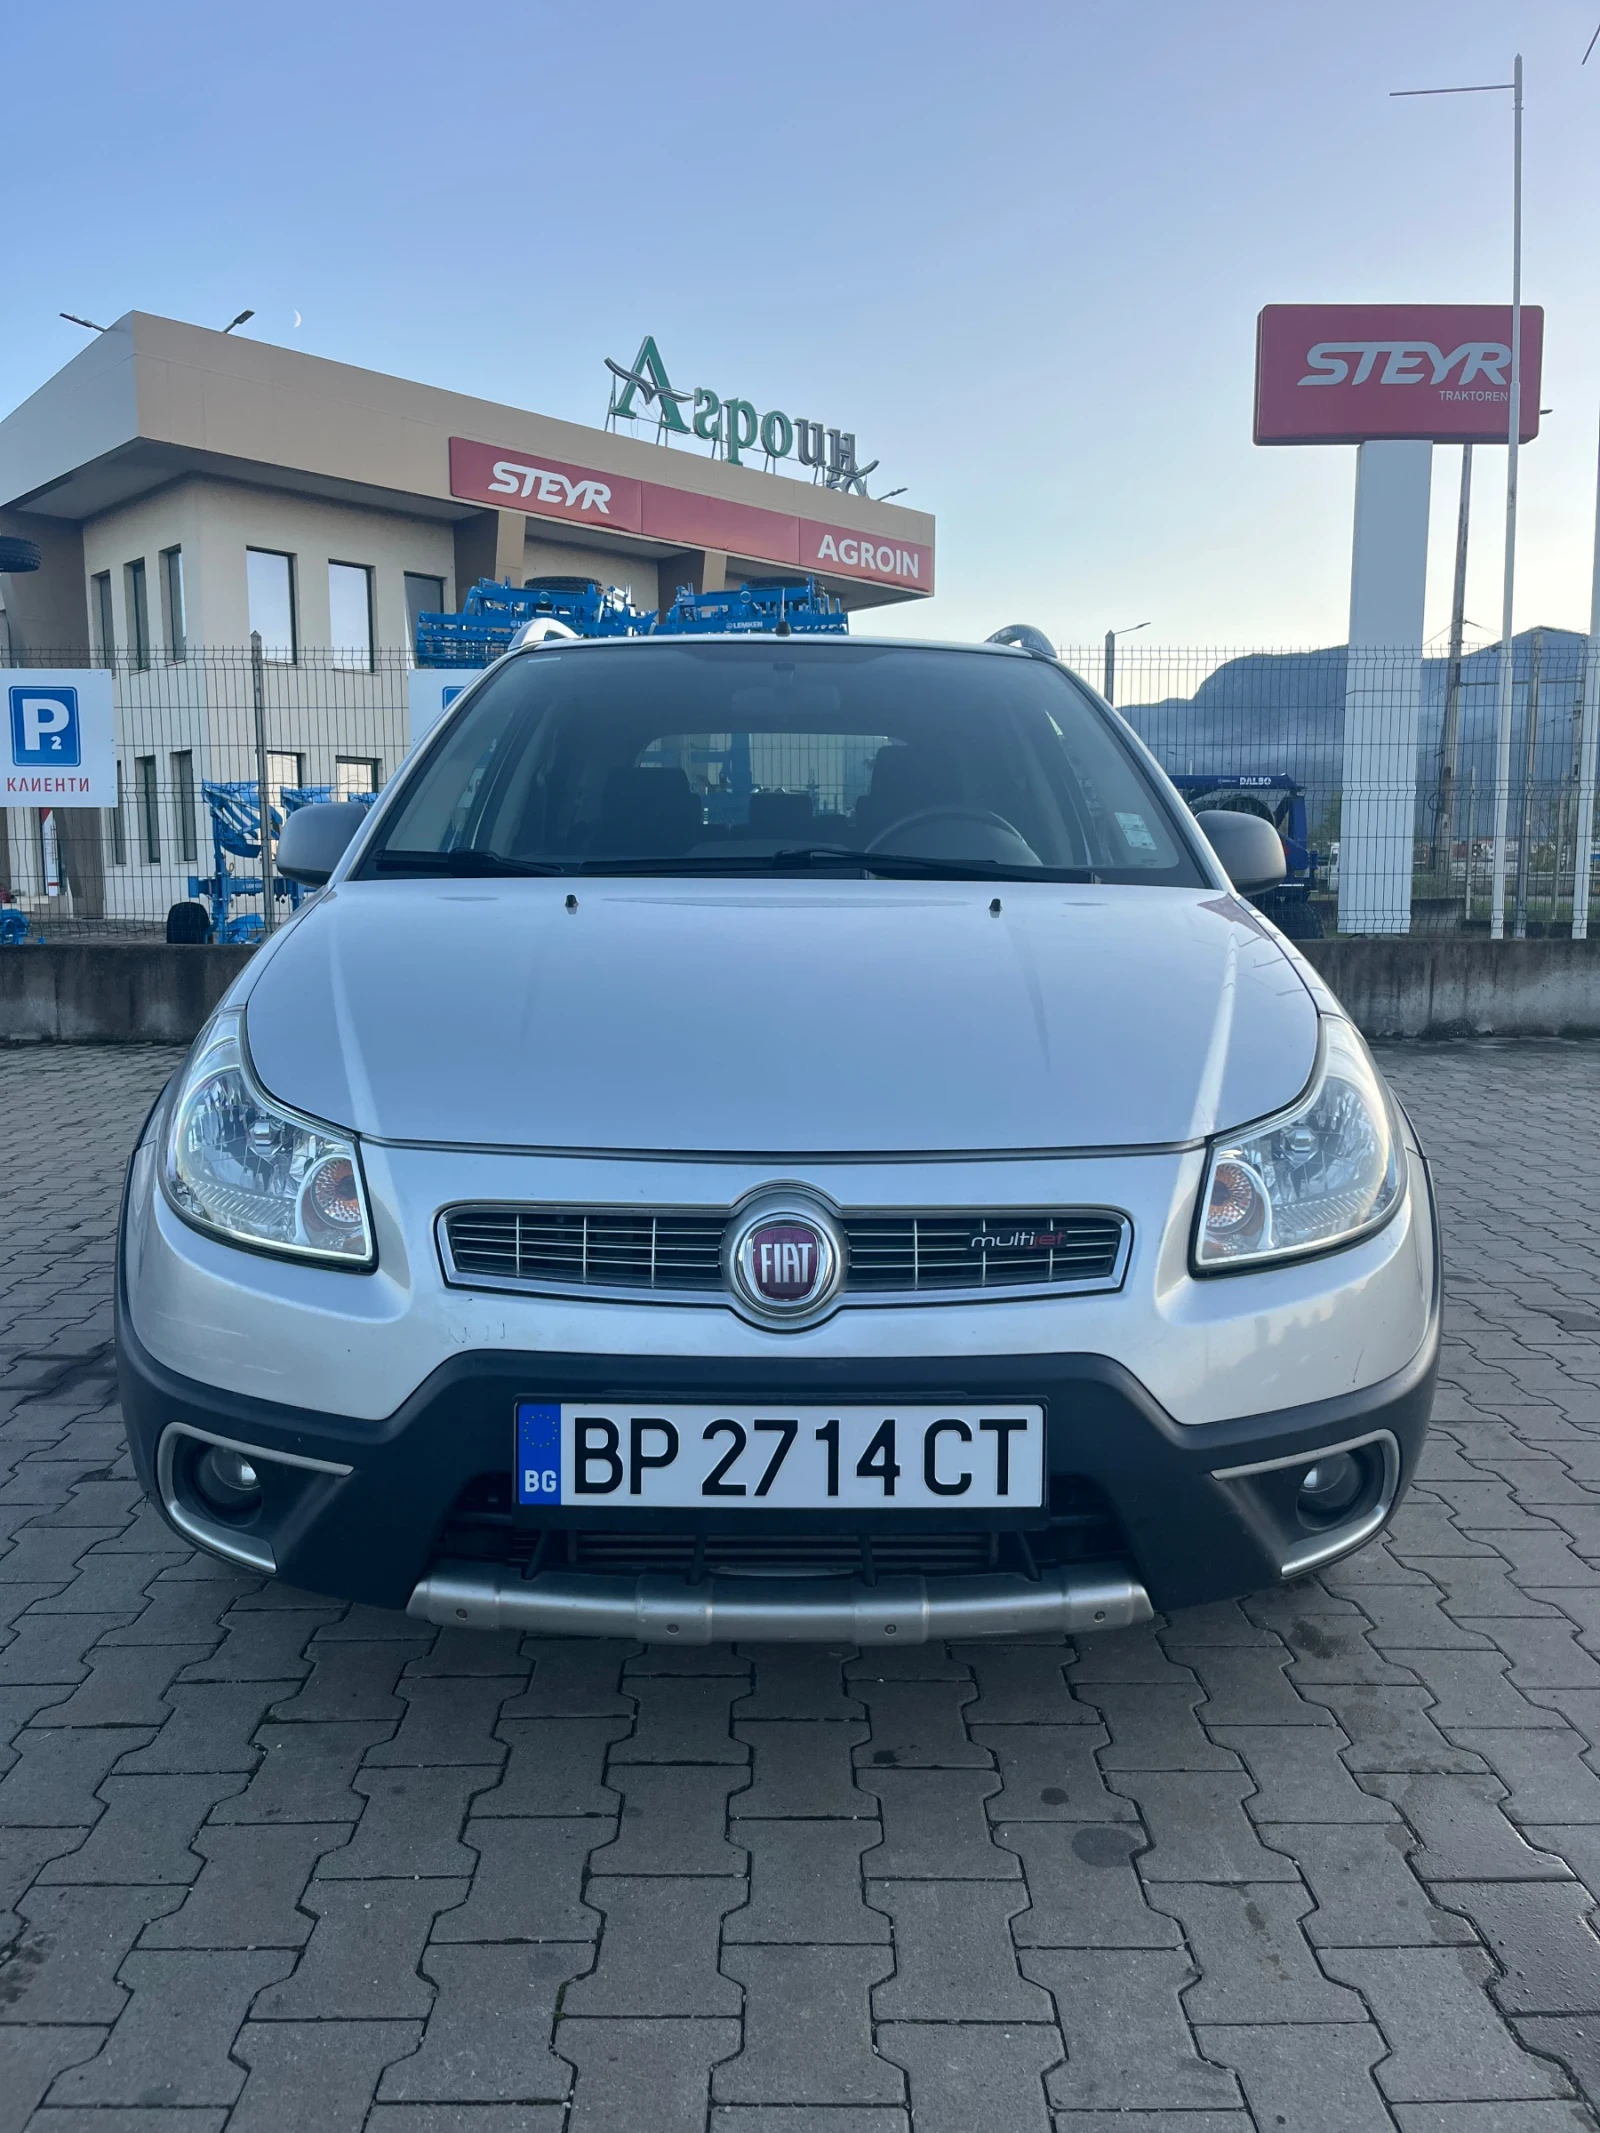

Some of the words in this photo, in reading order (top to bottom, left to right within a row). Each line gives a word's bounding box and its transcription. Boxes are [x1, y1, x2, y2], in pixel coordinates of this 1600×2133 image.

[1297, 341, 1512, 386] STEYR
[1439, 391, 1509, 401] TRAKTOREN
[488, 461, 612, 514] STEYR
[817, 534, 919, 579] AGROIN
[733, 621, 763, 629] LEMKEN
[6, 777, 90, 792] КЛИЕНТИ
[1240, 777, 1271, 785] DALBO
[971, 1231, 1066, 1250] multijet
[760, 1243, 813, 1284] FIAT
[573, 1416, 680, 1496] BP
[701, 1418, 901, 1497] 2714
[923, 1418, 1029, 1497] CT
[524, 1469, 557, 1493] BG
